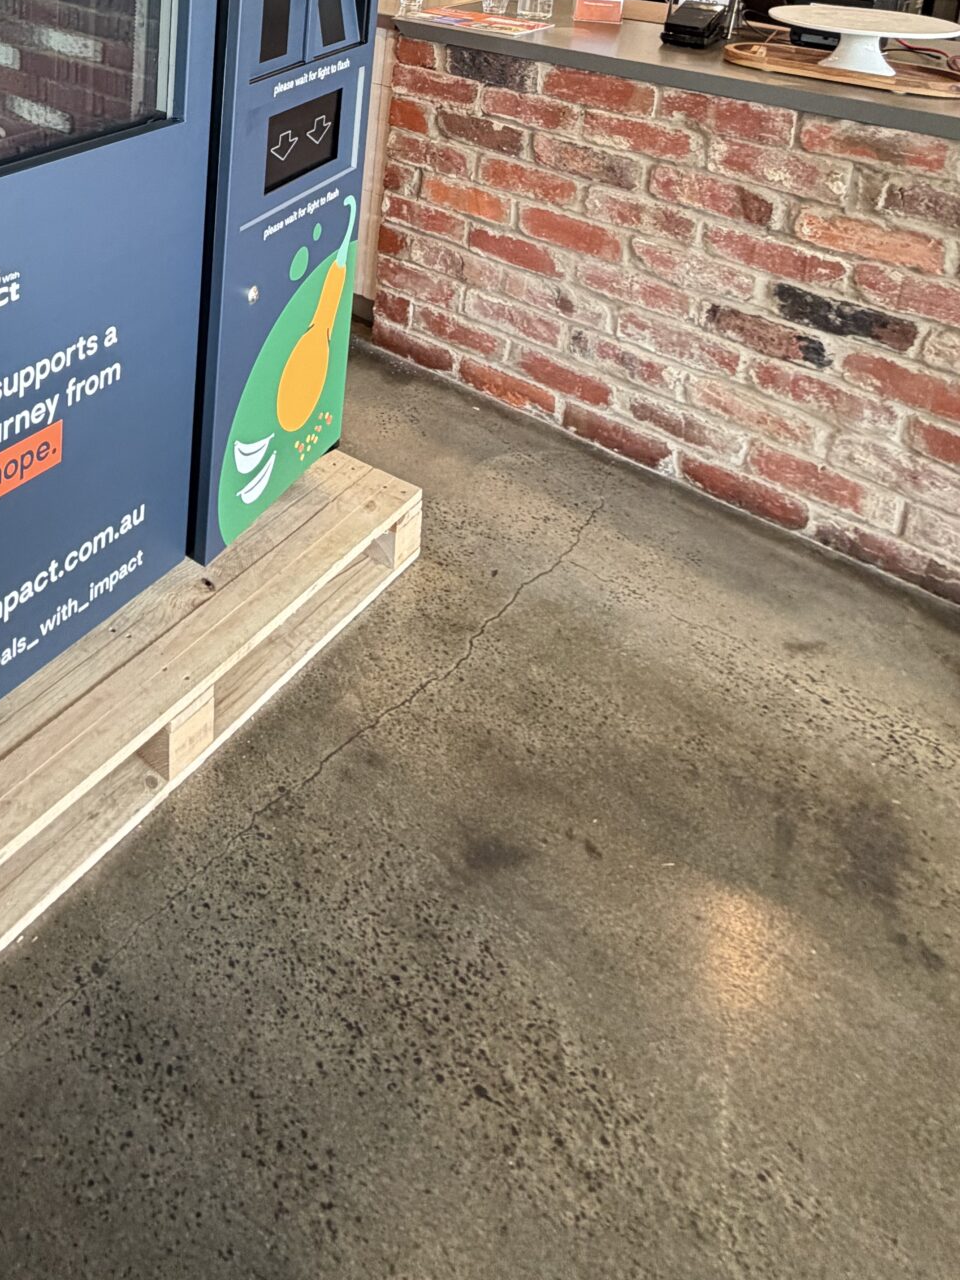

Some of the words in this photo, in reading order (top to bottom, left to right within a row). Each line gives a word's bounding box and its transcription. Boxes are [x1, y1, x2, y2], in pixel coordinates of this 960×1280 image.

[273, 80, 294, 98] please
[295, 72, 308, 86] wait
[308, 70, 318, 81] for
[317, 65, 331, 80] light
[331, 64, 337, 74] to
[263, 220, 284, 241] please
[284, 211, 298, 226] wait
[298, 207, 307, 219] for
[307, 199, 320, 215] light
[320, 196, 327, 206] to
[2, 271, 21, 284] with
[103, 325, 118, 348] a
[65, 362, 122, 408] from
